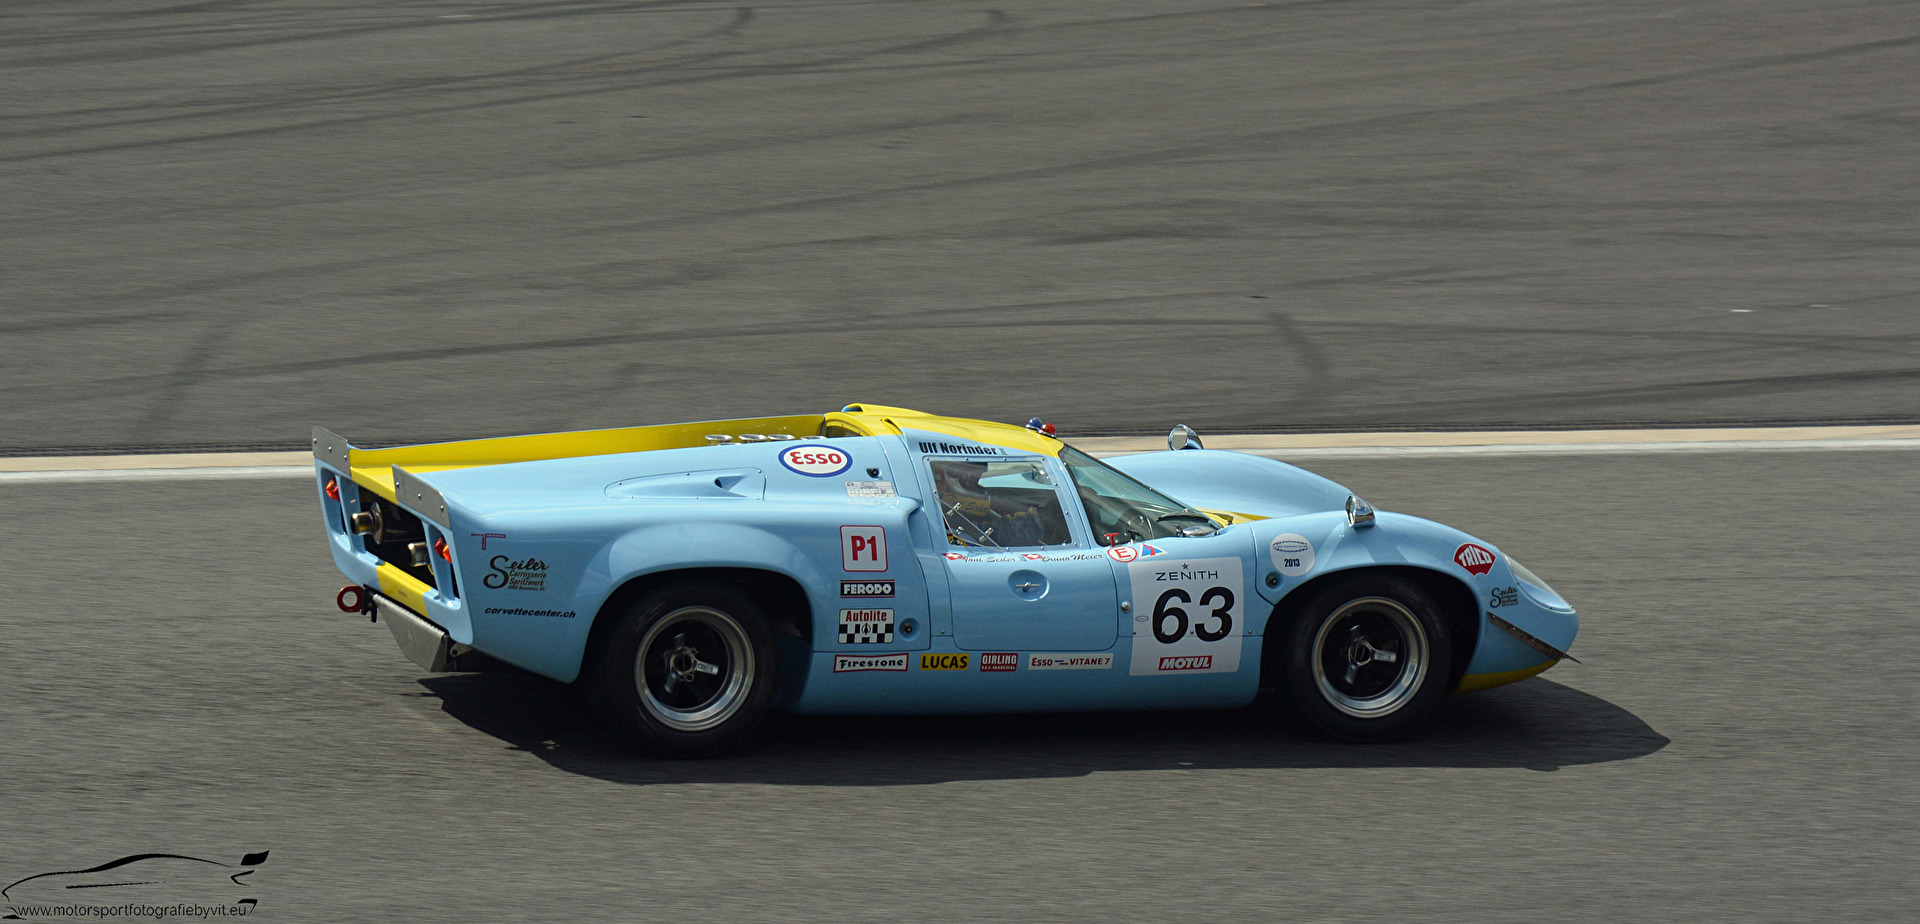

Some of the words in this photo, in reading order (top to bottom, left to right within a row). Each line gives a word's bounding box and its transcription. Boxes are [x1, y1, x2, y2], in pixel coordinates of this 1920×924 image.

[919, 442, 938, 454] Ulf
[939, 442, 997, 455] Norinder
[789, 451, 842, 465] Esso
[850, 535, 878, 561] P1
[1114, 547, 1132, 559] E
[1458, 545, 1493, 567] TRICO
[1284, 558, 1301, 568] 2013
[483, 555, 549, 589] Seiler
[509, 570, 547, 578] Carrosserie
[1155, 570, 1219, 581] ZENITH
[843, 583, 892, 595] FERODO
[485, 607, 576, 618] corvettecenter.ch
[845, 610, 887, 622] Autolite
[1152, 586, 1235, 645] 63
[839, 658, 904, 670] Firestone
[921, 655, 968, 669] LUCAS
[982, 655, 1017, 665] GIRLING
[1031, 657, 1053, 667] Esso
[1070, 657, 1103, 666] VITANE
[1104, 657, 1111, 665] 7
[1160, 656, 1210, 669] MOTUL
